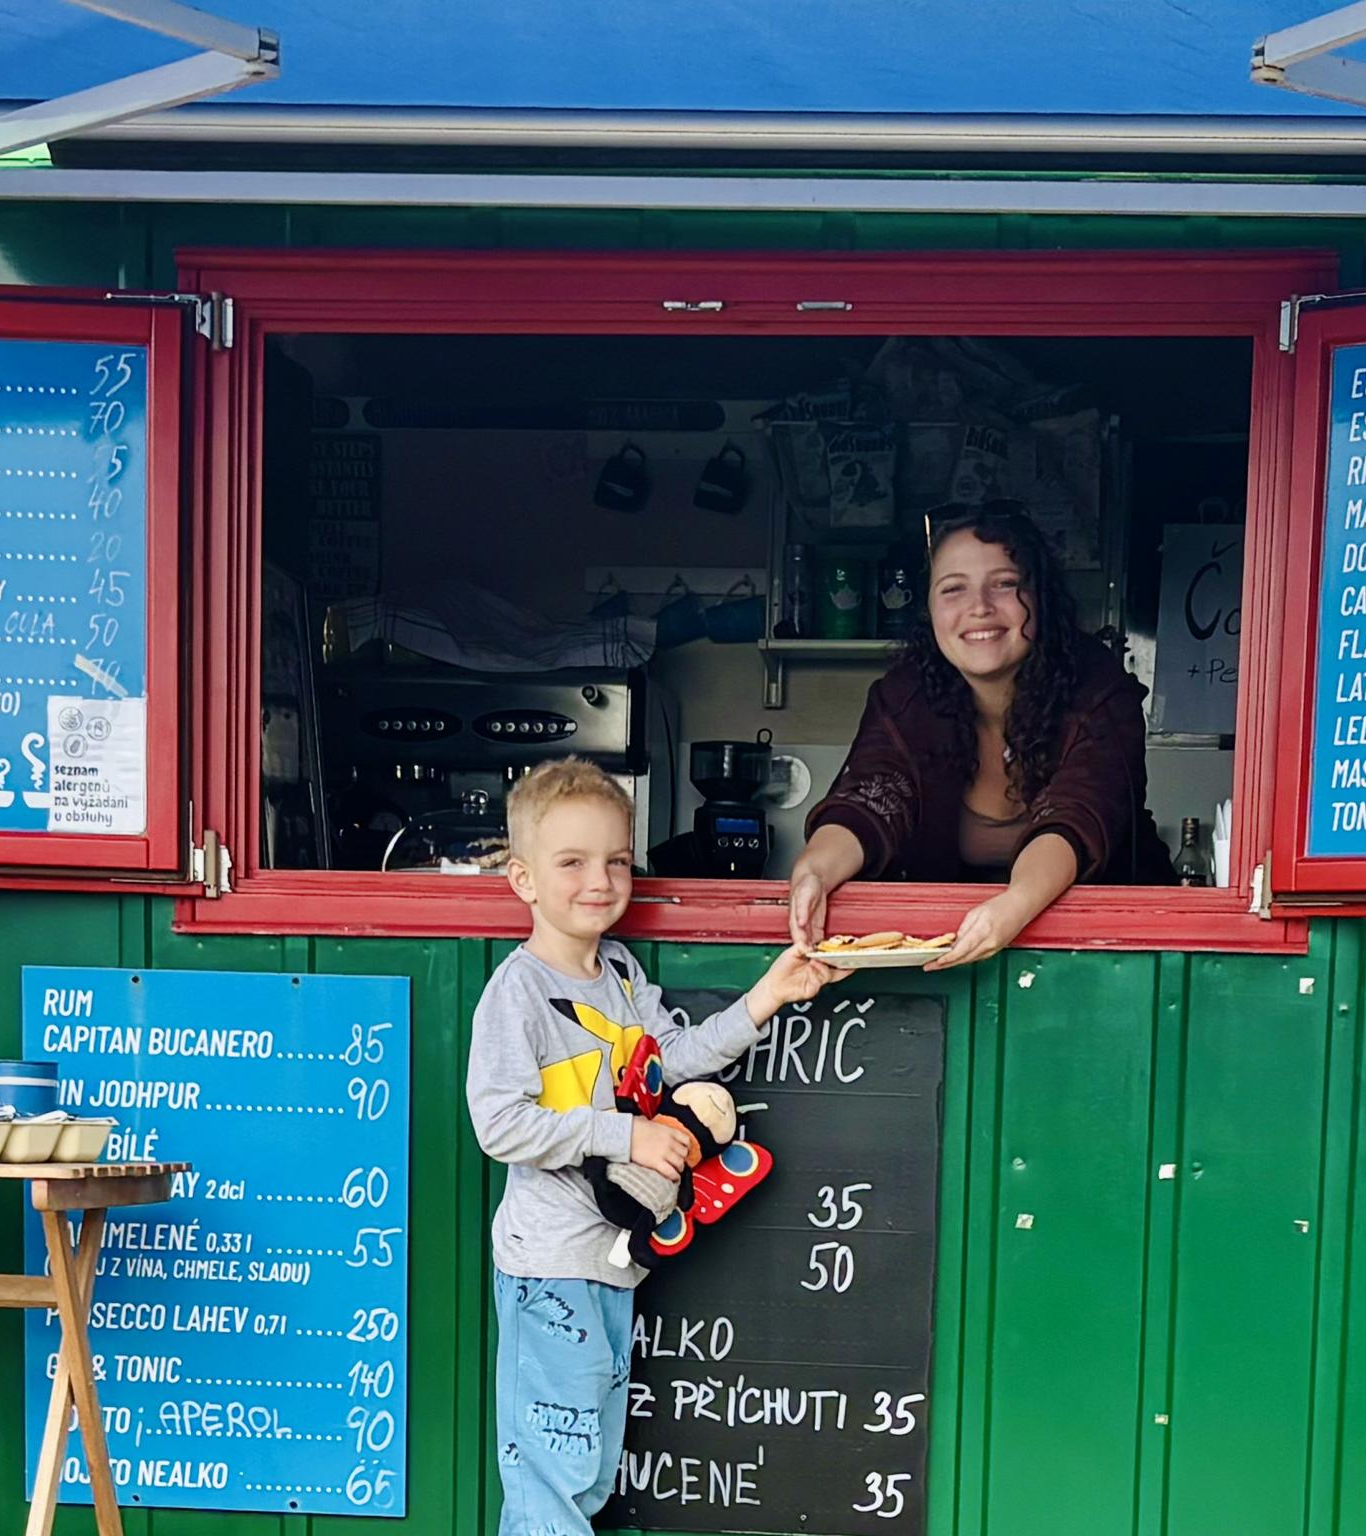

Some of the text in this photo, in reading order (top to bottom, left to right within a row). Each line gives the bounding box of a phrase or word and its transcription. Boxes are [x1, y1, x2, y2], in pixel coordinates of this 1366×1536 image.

[89, 352, 137, 397] 55
[89, 400, 125, 435] 70
[88, 567, 131, 607] 45
[85, 613, 120, 651] 50
[54, 764, 99, 777] seznam
[54, 795, 69, 807] na
[43, 988, 93, 1017] RUM
[43, 1023, 393, 1066] CAPITAN BUCANERO 85
[719, 998, 875, 1084] HŘÍČ
[56, 1076, 390, 1121] IN JODHPUR 90
[107, 1127, 159, 1162] BÍLÉ
[343, 1166, 389, 1209] 60
[807, 1183, 873, 1231] 35
[345, 1228, 403, 1268] 55
[800, 1241, 854, 1293] 50
[110, 1257, 122, 1276] Z
[126, 1253, 168, 1280] VÍNA,
[173, 1259, 243, 1284] CHMELE,
[248, 1262, 311, 1287] SLADU)
[172, 1305, 250, 1333] LAHEV
[346, 1307, 399, 1343] 250
[630, 1313, 735, 1362] ALKO
[92, 1354, 107, 1381] &
[114, 1354, 182, 1384] TONIC
[347, 1359, 395, 1399] 140
[159, 1400, 293, 1436] APEROL
[346, 1404, 396, 1454] 90
[671, 1375, 847, 1431] PŘÍCHUTI
[863, 1391, 925, 1436] 35
[137, 1460, 229, 1491] NEALKO
[345, 1462, 399, 1508] 65
[615, 1445, 912, 1518] HUCENÉ 35
